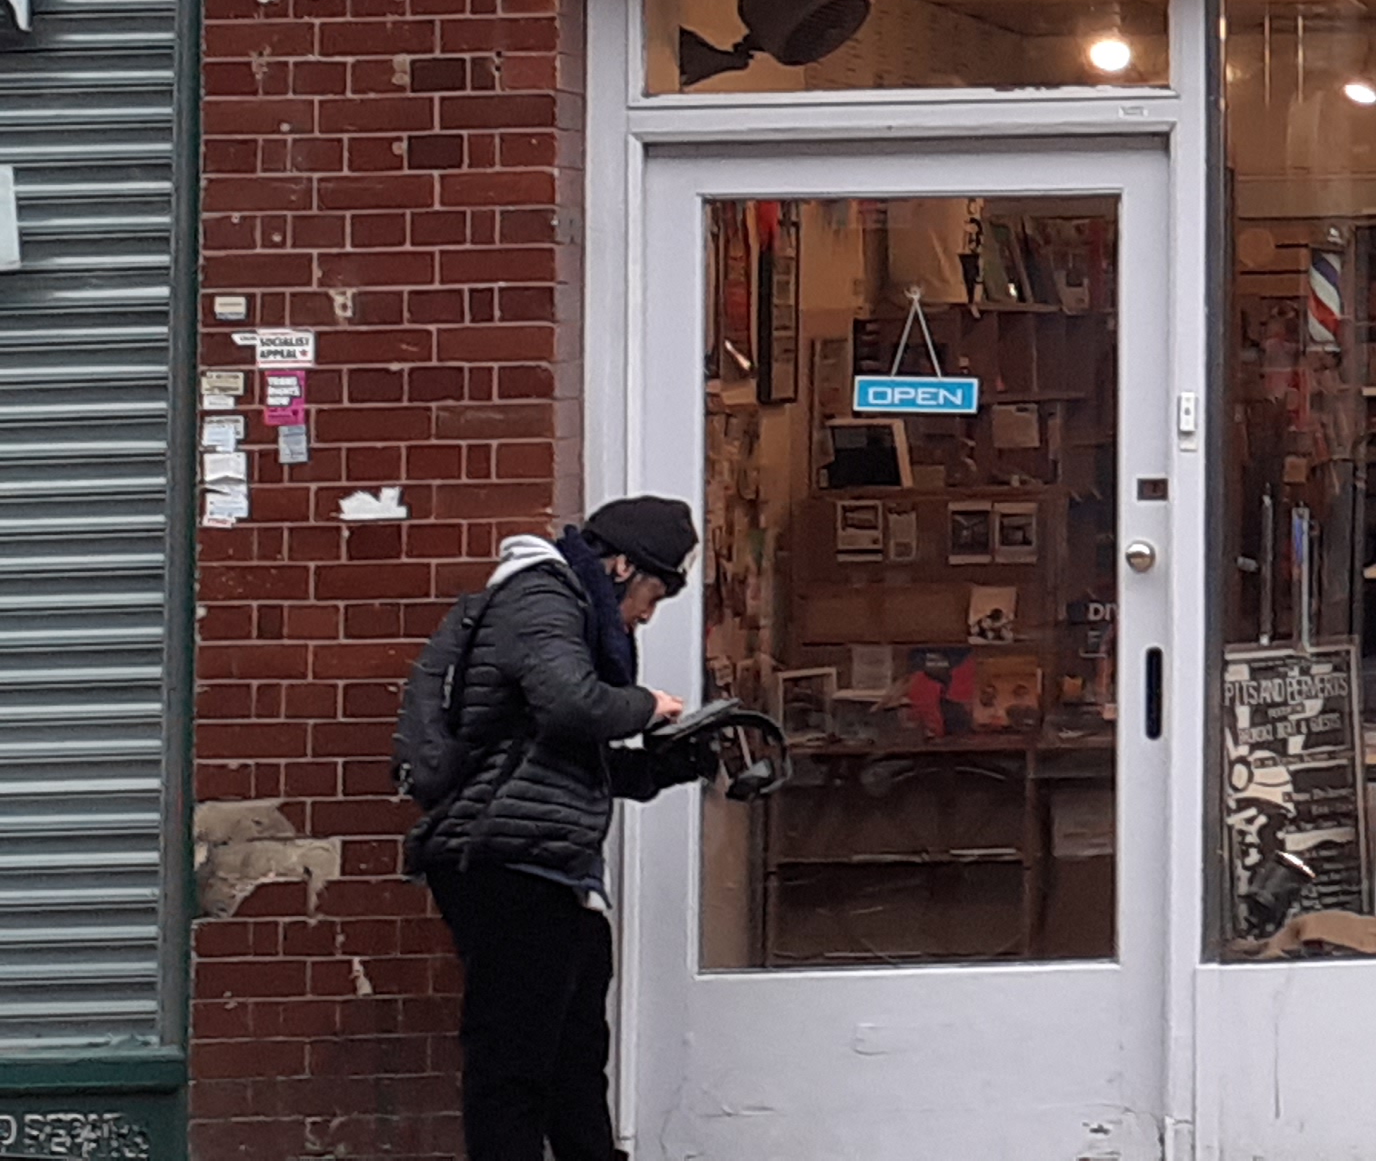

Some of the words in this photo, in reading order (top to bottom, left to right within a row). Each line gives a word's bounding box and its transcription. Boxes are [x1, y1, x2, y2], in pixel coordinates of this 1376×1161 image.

[260, 336, 309, 347] SOCIALIST
[260, 349, 297, 359] APPEAL
[867, 386, 964, 406] OPEN
[1224, 680, 1258, 706] PITS
[1286, 672, 1349, 704] PERVERTS
